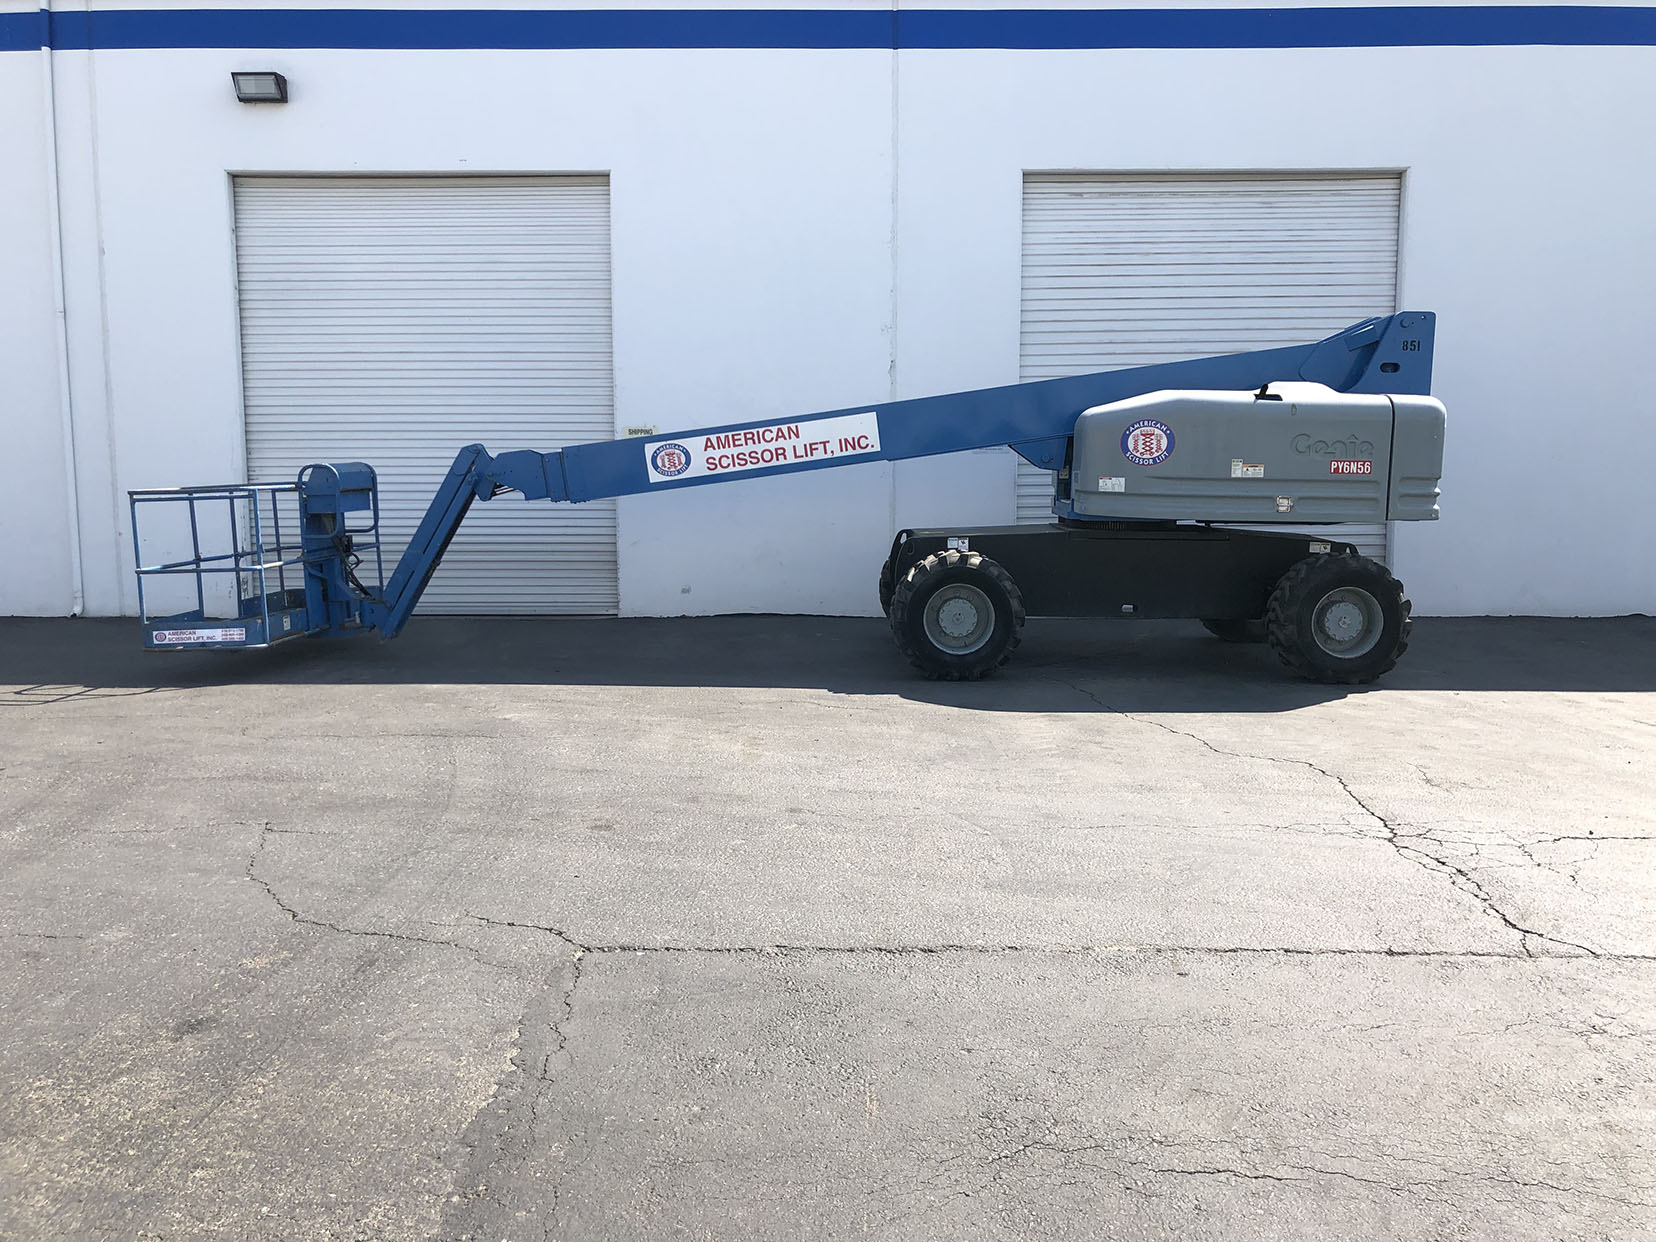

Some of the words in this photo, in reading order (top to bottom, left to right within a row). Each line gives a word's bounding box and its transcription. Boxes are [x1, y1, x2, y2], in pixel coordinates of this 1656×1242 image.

[1401, 339, 1421, 352] 851
[1129, 420, 1168, 433] AMERICAN
[703, 424, 801, 452] AMERICAN
[655, 444, 684, 454] AMERICAN
[705, 446, 792, 472] SCISSOR
[793, 440, 835, 460] LIFT,
[839, 434, 875, 453] INC.
[1126, 451, 1154, 465] SCISSOR
[1156, 451, 1169, 463] LIFT
[657, 468, 678, 476] SCISSOR
[1330, 461, 1371, 474] PY6N56
